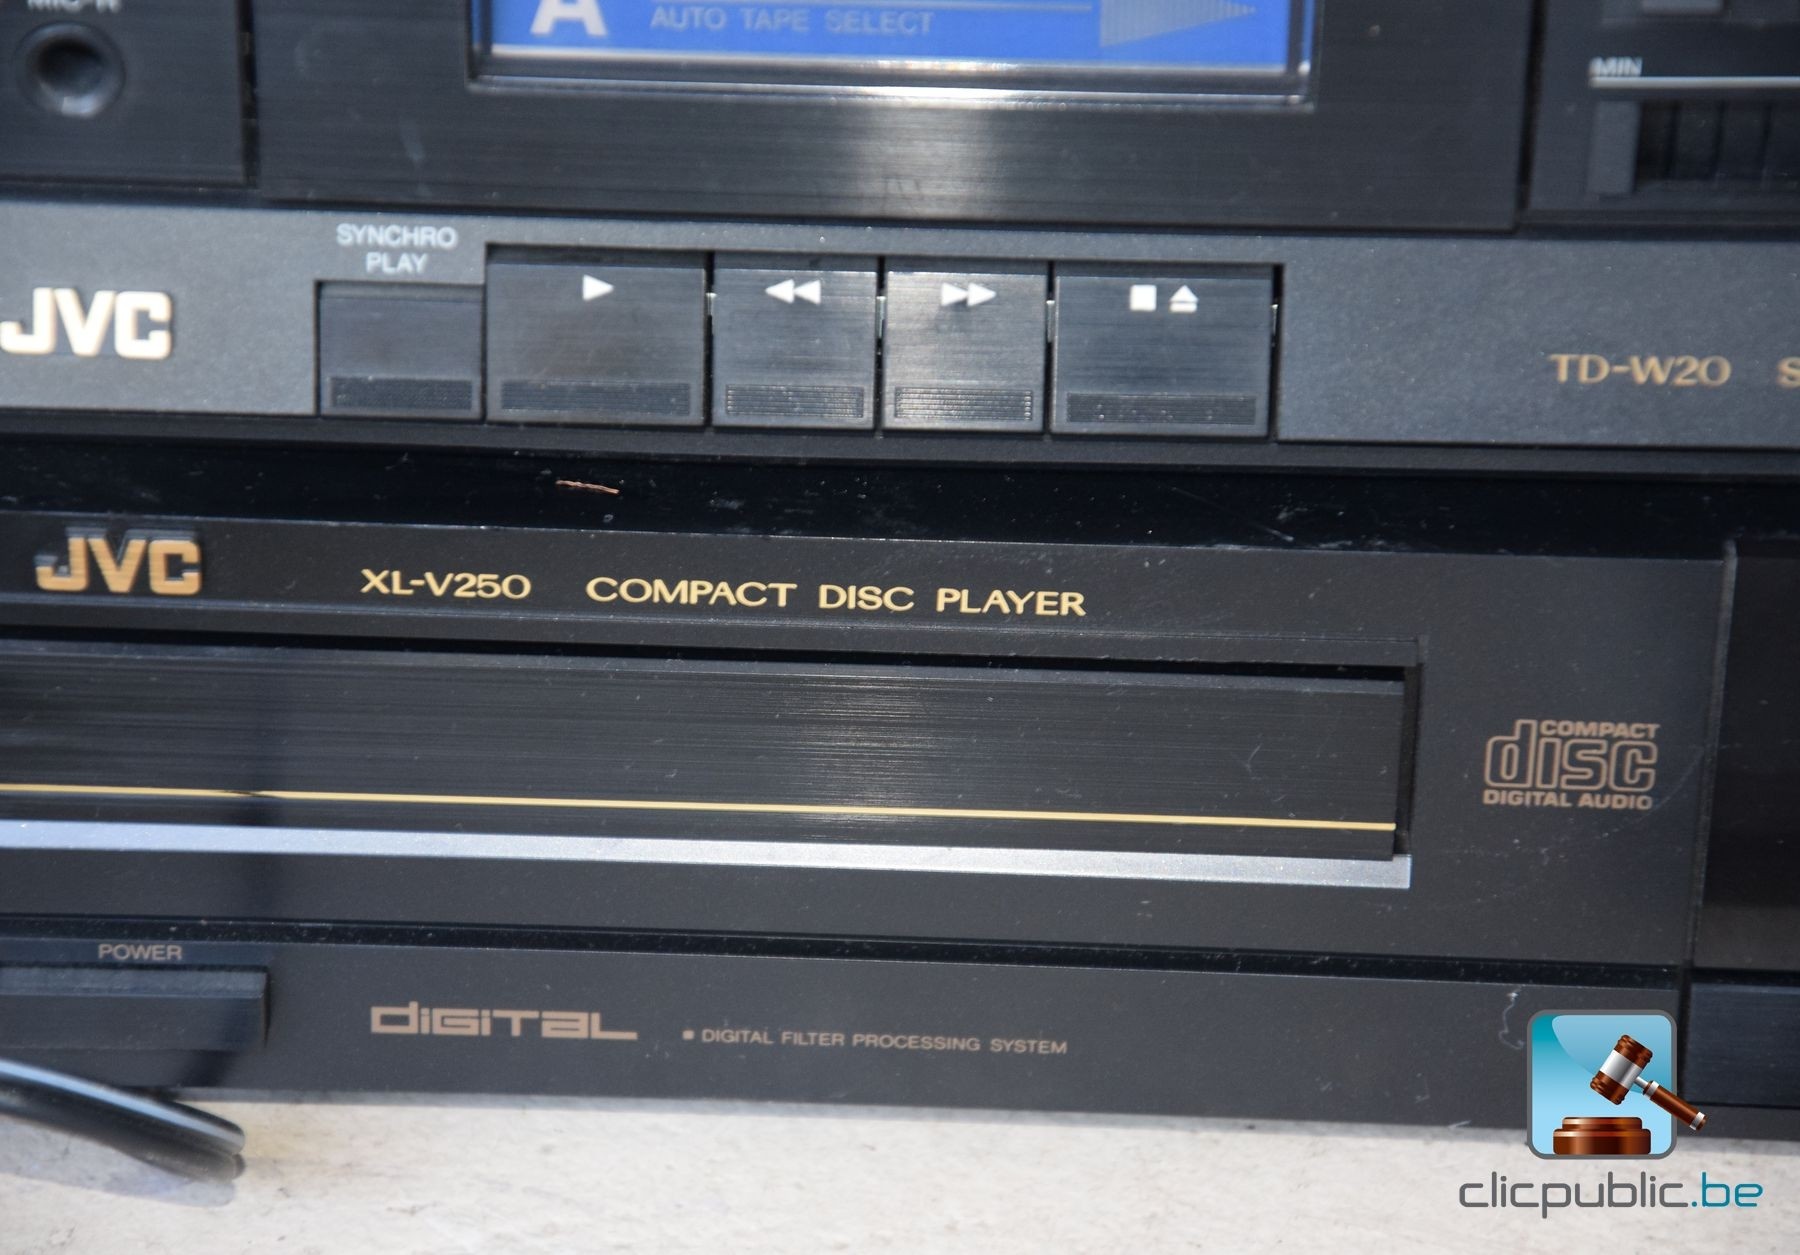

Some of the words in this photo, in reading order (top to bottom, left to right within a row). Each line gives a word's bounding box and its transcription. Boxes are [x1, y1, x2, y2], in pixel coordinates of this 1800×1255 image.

[650, 6, 726, 30] AUTO
[740, 8, 809, 32] TAPE
[825, 10, 934, 36] SELECT
[1589, 56, 1643, 76] MIN
[336, 223, 457, 250] SYNCHRO
[365, 251, 427, 275] PLAY
[0, 287, 173, 361] JVC
[1548, 353, 1732, 388] TD-W20
[35, 530, 201, 595] JVC
[360, 567, 532, 601] XL-V250
[585, 575, 798, 608] COMPACT
[818, 583, 915, 613] DISC
[935, 586, 1087, 618] PLAYER
[1539, 719, 1661, 739] COMPACT
[1483, 790, 1572, 808] DIGITAL
[1577, 793, 1654, 811] AUDIO
[98, 943, 183, 962] POWER
[701, 1027, 774, 1046] DIGITAL
[781, 1030, 845, 1048] FILTER
[852, 1032, 981, 1053] PROCESSING
[989, 1036, 1068, 1055] SYSTEM
